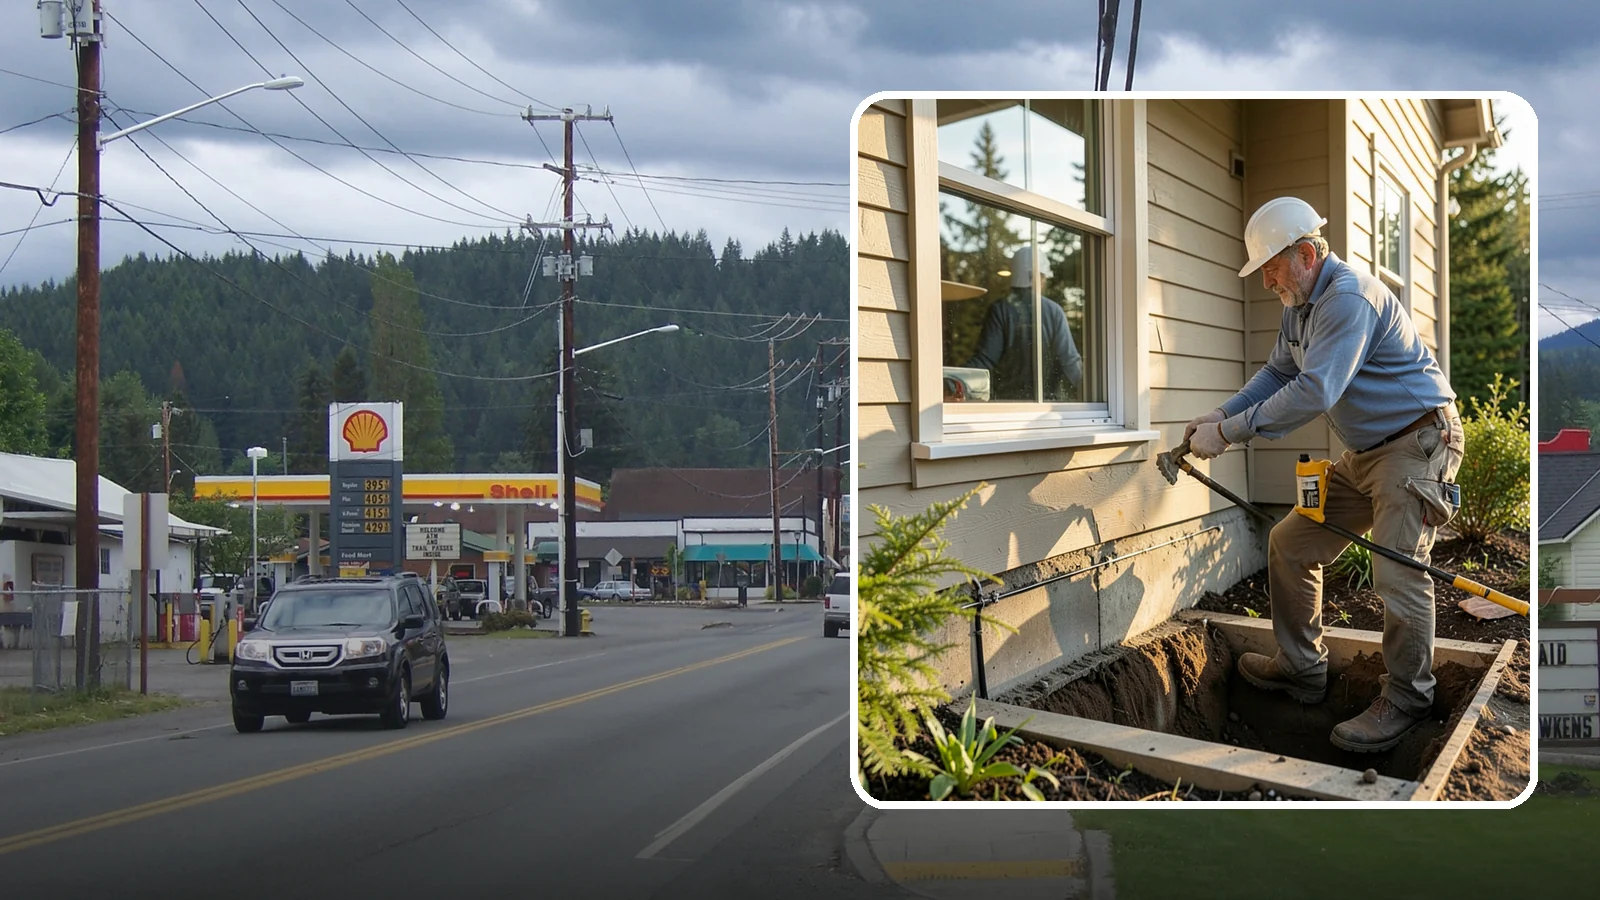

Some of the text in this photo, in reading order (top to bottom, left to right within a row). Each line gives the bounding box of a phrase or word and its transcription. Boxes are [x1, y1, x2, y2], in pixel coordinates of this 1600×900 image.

[366, 480, 383, 490] 395
[490, 484, 547, 499] Shell
[366, 494, 383, 504] 405
[366, 508, 383, 518] 415
[366, 522, 383, 532] 429
